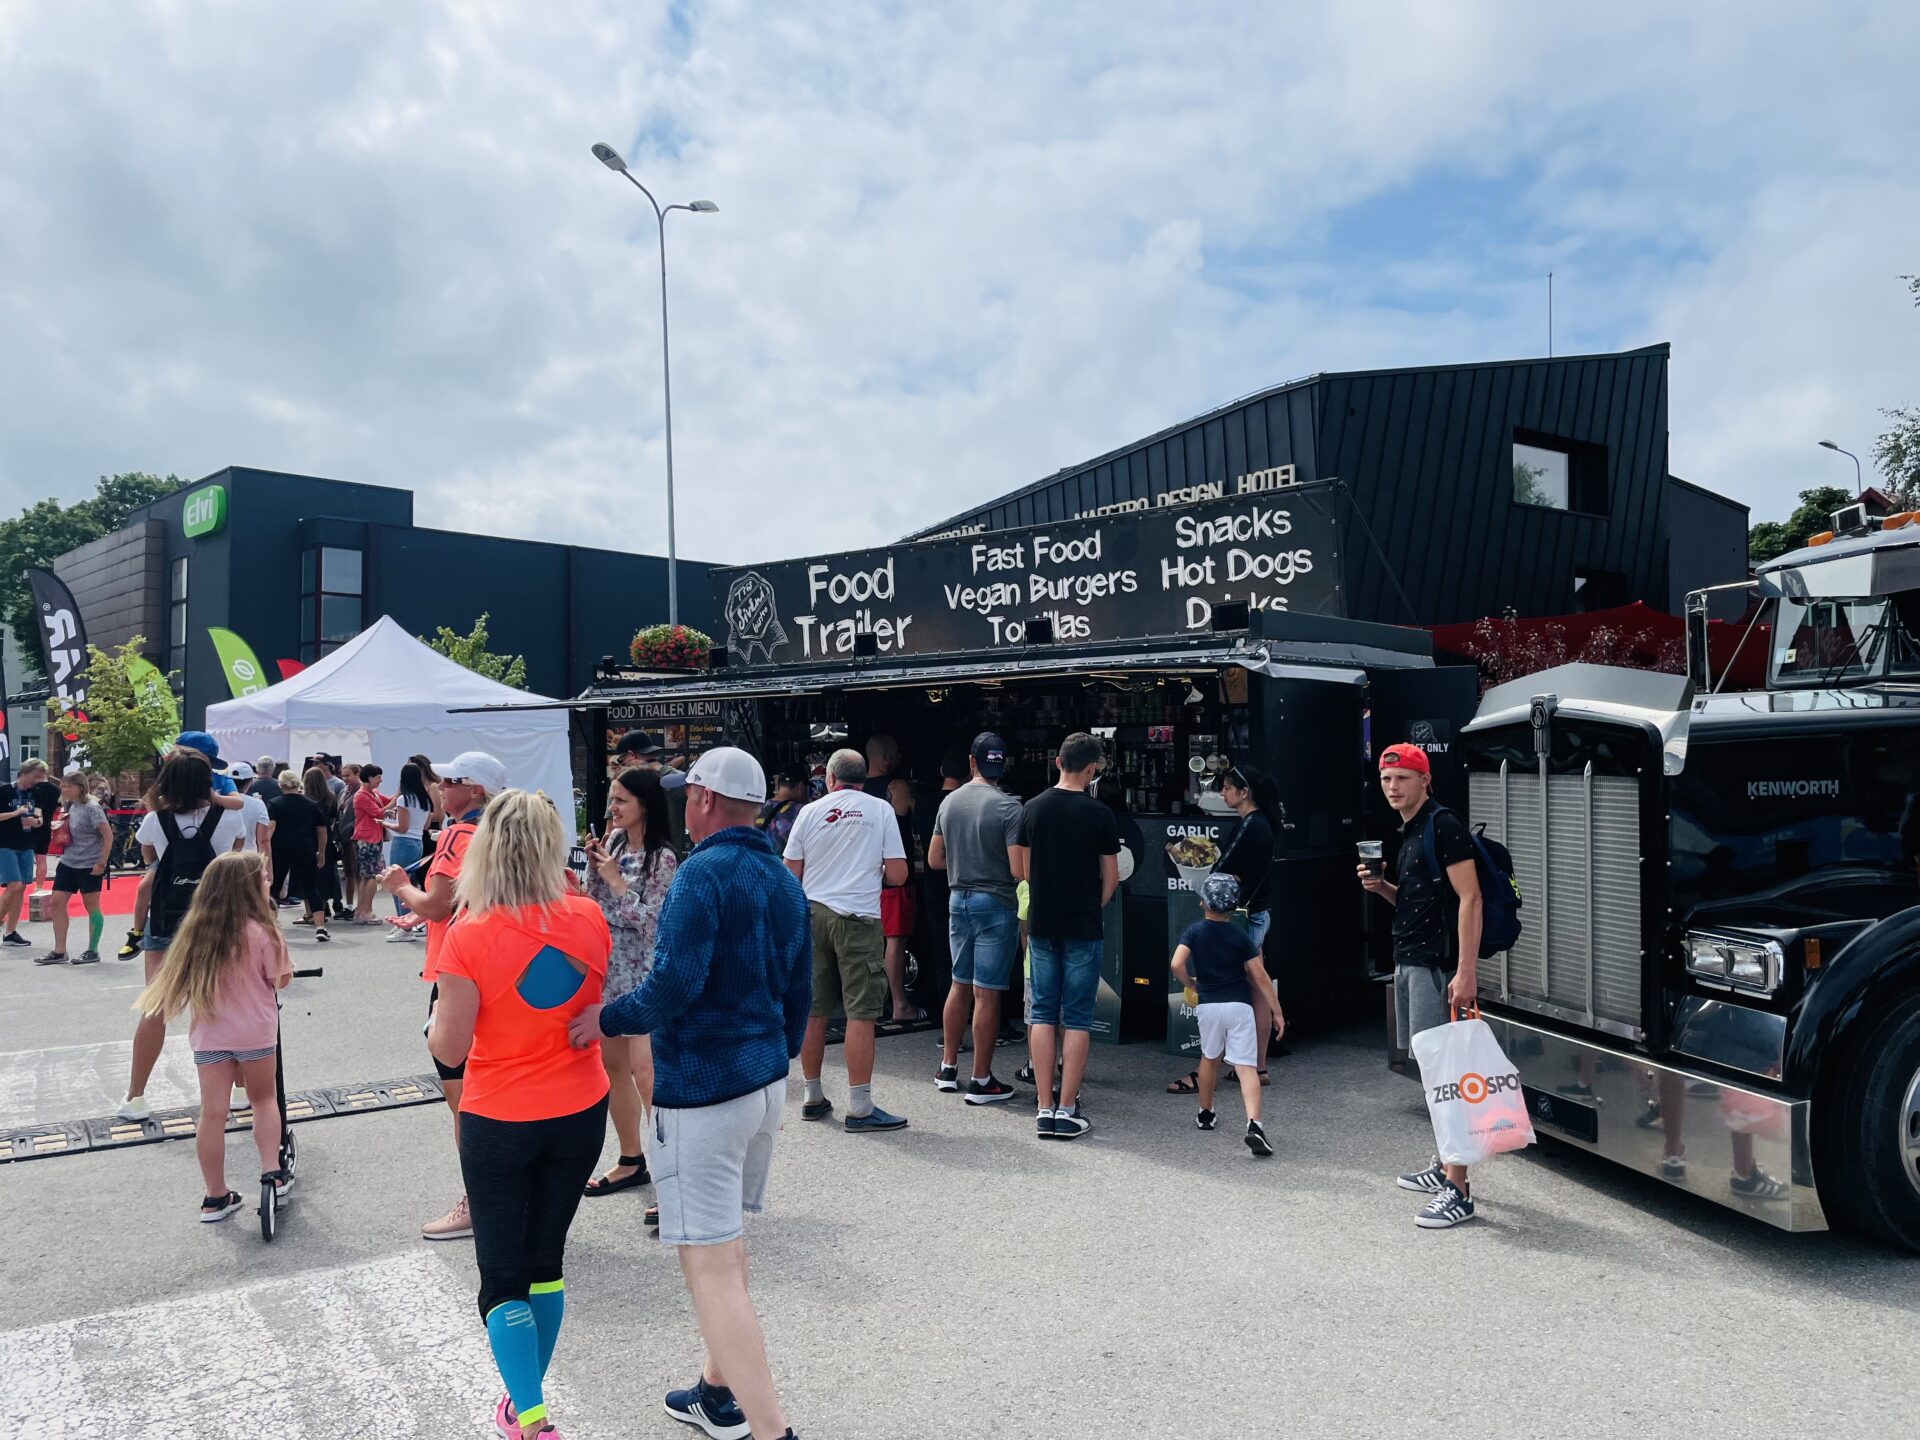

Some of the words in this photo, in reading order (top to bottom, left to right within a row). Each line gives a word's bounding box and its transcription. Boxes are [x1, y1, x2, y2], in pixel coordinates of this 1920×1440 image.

[1157, 480, 1224, 507] DESIGN
[1237, 464, 1303, 495] HOTEL
[186, 488, 214, 527] elvi
[1175, 506, 1292, 548] Snacks
[971, 542, 1025, 576] Fast
[1033, 529, 1102, 569] Food
[1161, 555, 1216, 591] Hot
[1226, 548, 1313, 585] Dogs
[808, 556, 895, 611] Food
[944, 582, 1021, 615] Vegan
[1029, 570, 1138, 605] Burgers
[1185, 592, 1289, 629] Dks
[793, 608, 912, 658] Trailer
[607, 706, 636, 719] FOOD
[639, 703, 684, 717] TRAILER
[688, 701, 720, 716] MENU
[1426, 743, 1449, 753] ONLY
[1747, 779, 1840, 797] KENWORTH
[1166, 825, 1220, 839] GARLIC
[1433, 1072, 1520, 1106] ZEROSPO
